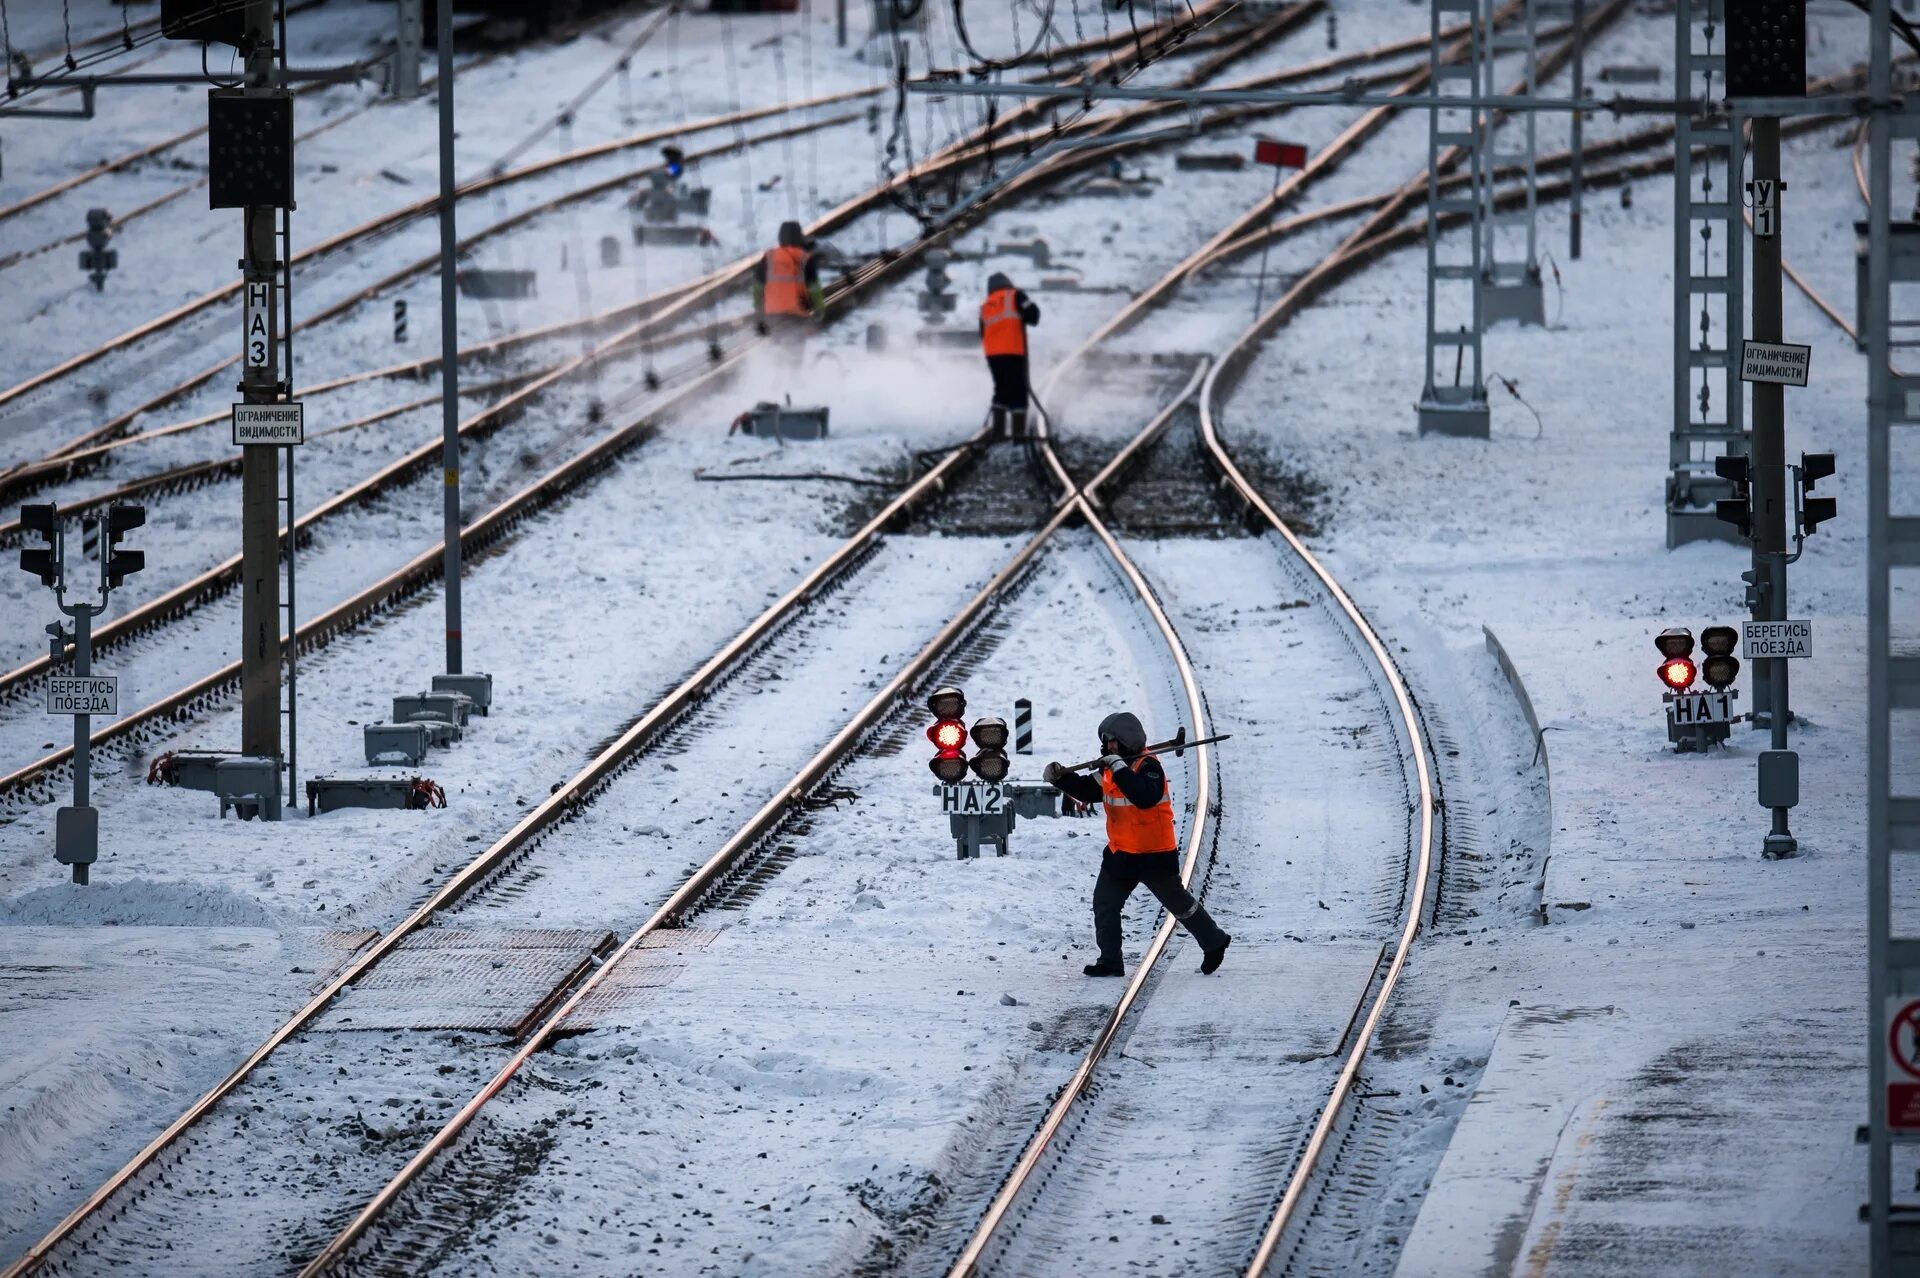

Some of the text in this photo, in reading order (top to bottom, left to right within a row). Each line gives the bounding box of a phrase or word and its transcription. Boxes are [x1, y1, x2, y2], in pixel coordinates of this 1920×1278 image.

[1757, 181, 1771, 233] У1
[250, 285, 267, 364] НА3
[1746, 347, 1806, 364] ОГРАНИЧЕНИЕ
[1746, 363, 1803, 379] ВИДИМОСТИ
[237, 410, 299, 422] ОГРАНИЧЕНИЕ
[239, 426, 297, 439] ВИДИМОСТИ
[1746, 624, 1809, 638] БЕРЕГИСЬ
[1751, 640, 1805, 655] ПОЕЗДА
[51, 680, 114, 694] БЕРЕГИСЬ
[55, 696, 109, 712] ПОЕЗДА
[1676, 694, 1728, 722] НА1
[943, 786, 1001, 812] НА2
